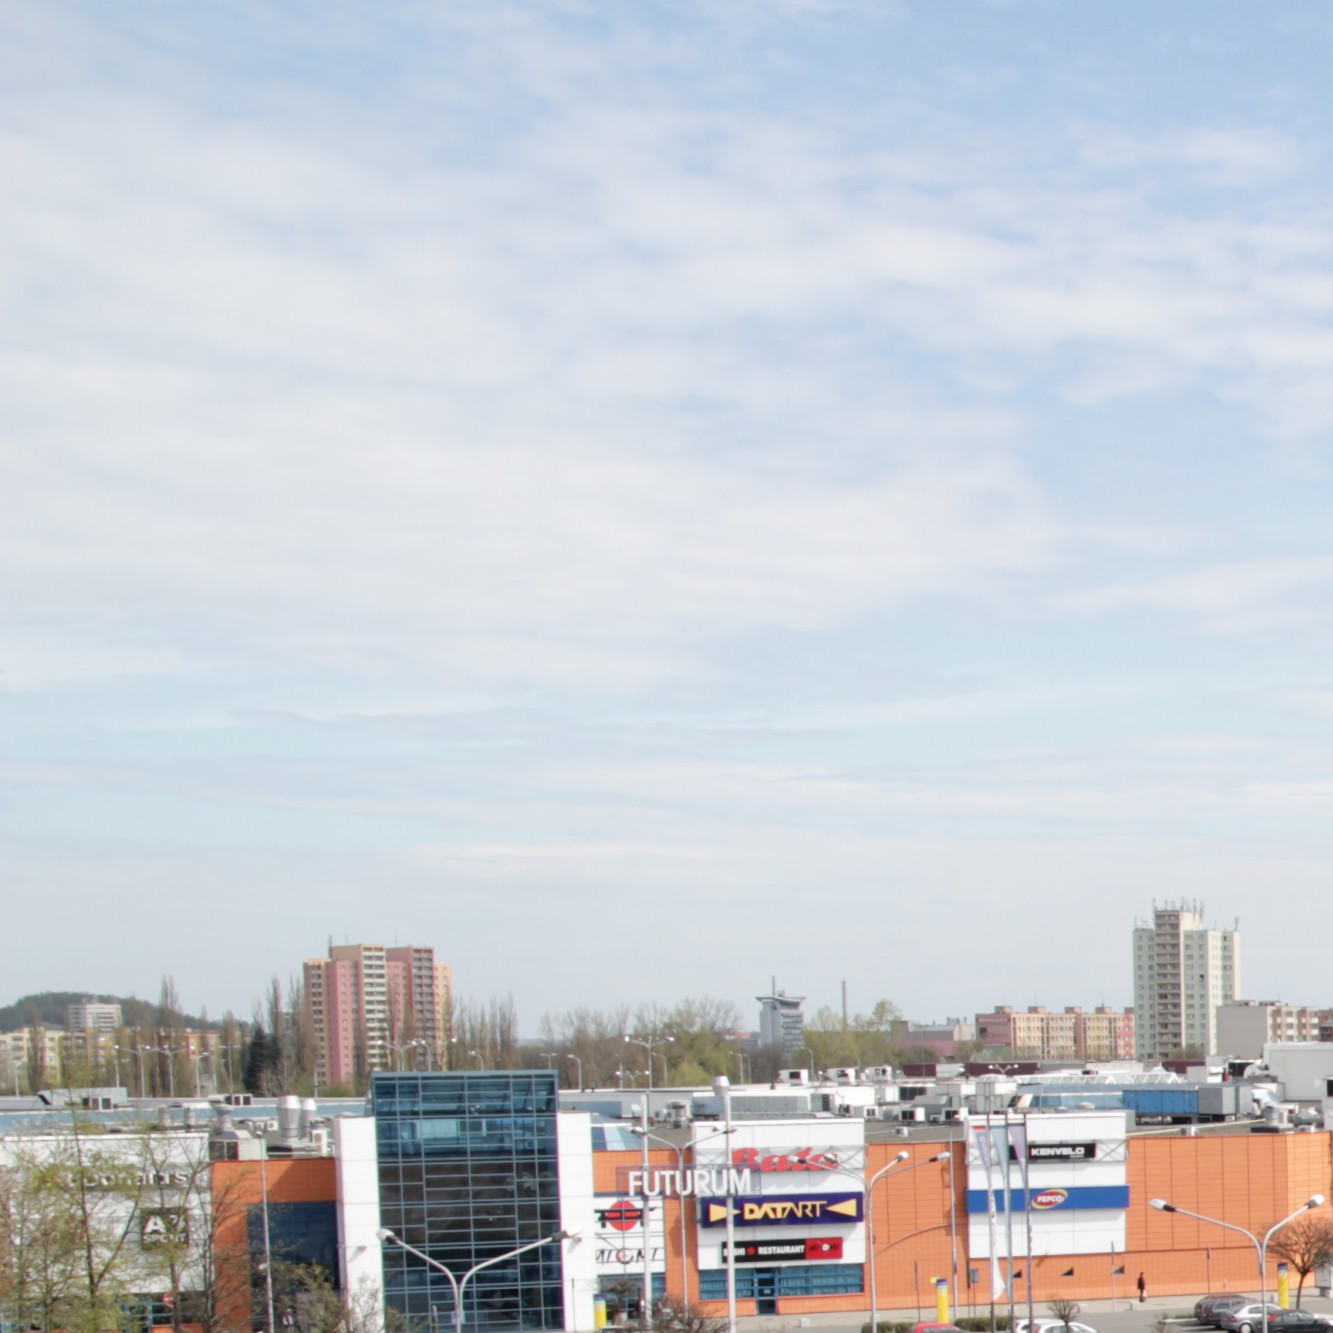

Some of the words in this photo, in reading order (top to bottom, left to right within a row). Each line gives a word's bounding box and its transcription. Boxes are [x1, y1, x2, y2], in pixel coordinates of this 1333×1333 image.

[1031, 1147, 1085, 1157] KENVELO
[629, 1168, 750, 1197] FUTURUM
[1037, 1195, 1063, 1203] PEPCO
[744, 1200, 827, 1220] DATART
[758, 1244, 805, 1256] RESTAURANT
